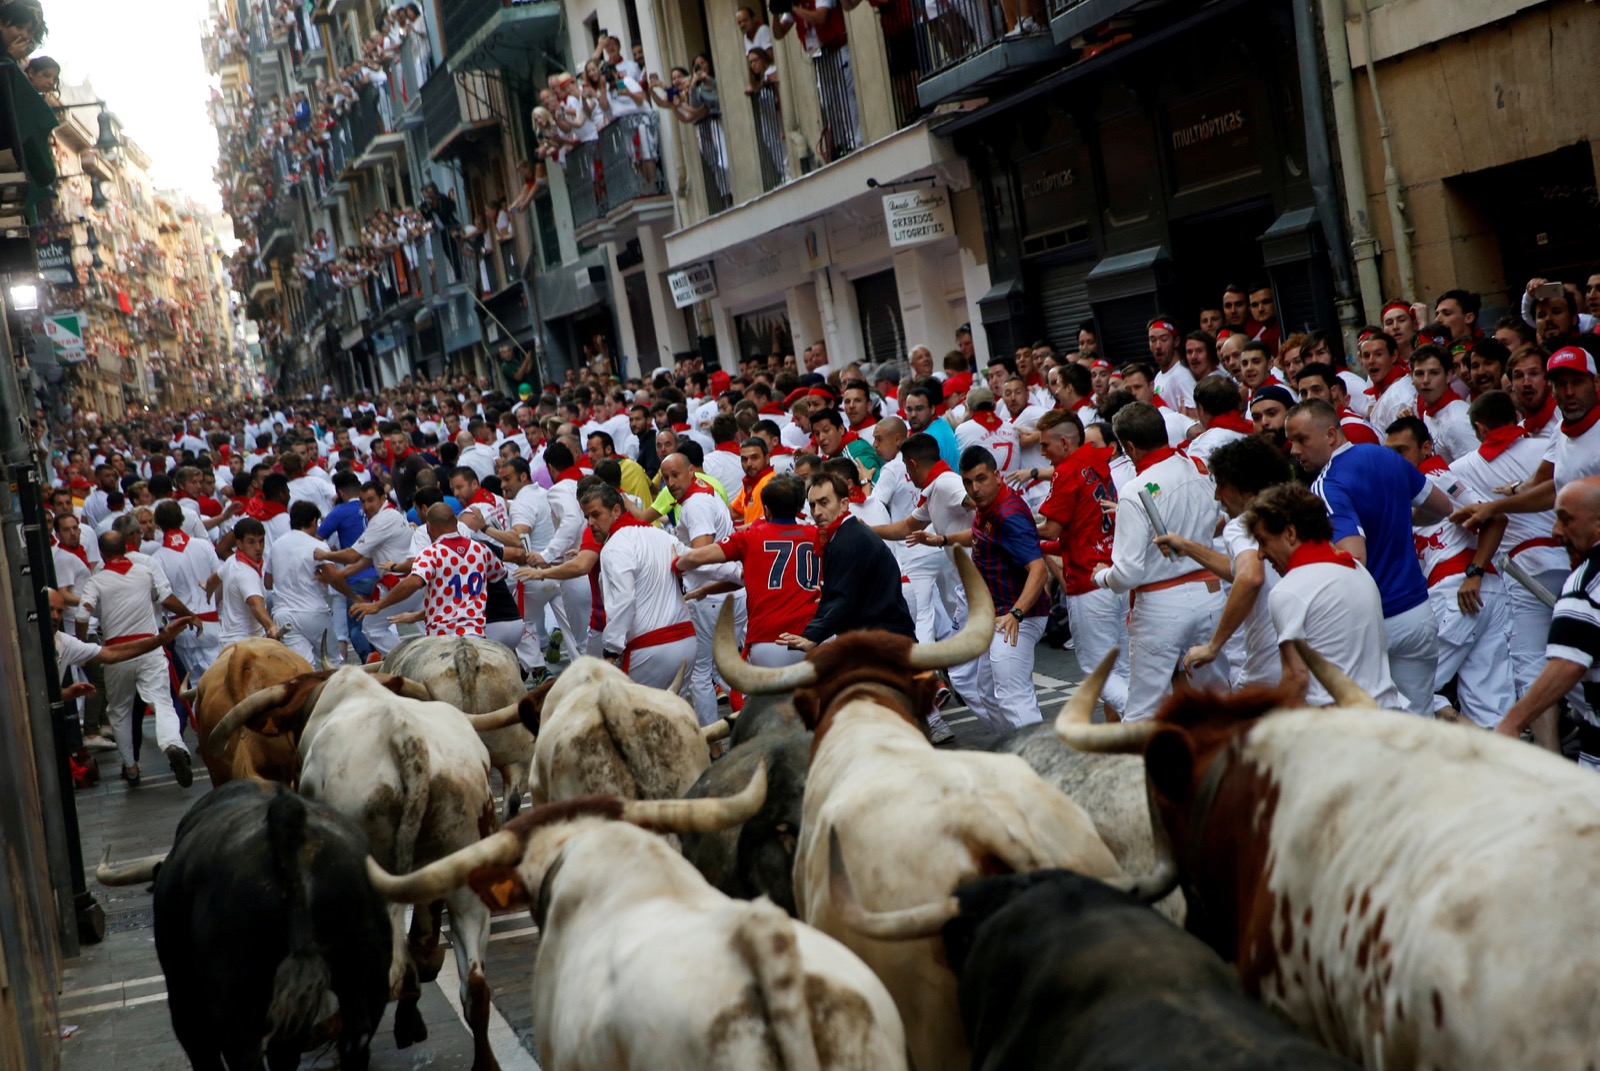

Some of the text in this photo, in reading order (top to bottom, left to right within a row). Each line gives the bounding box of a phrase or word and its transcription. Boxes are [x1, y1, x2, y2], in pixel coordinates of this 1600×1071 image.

[892, 212, 934, 228] GRABADOS
[993, 442, 1013, 471] 7
[763, 540, 821, 592] 70
[448, 571, 483, 599] 10
